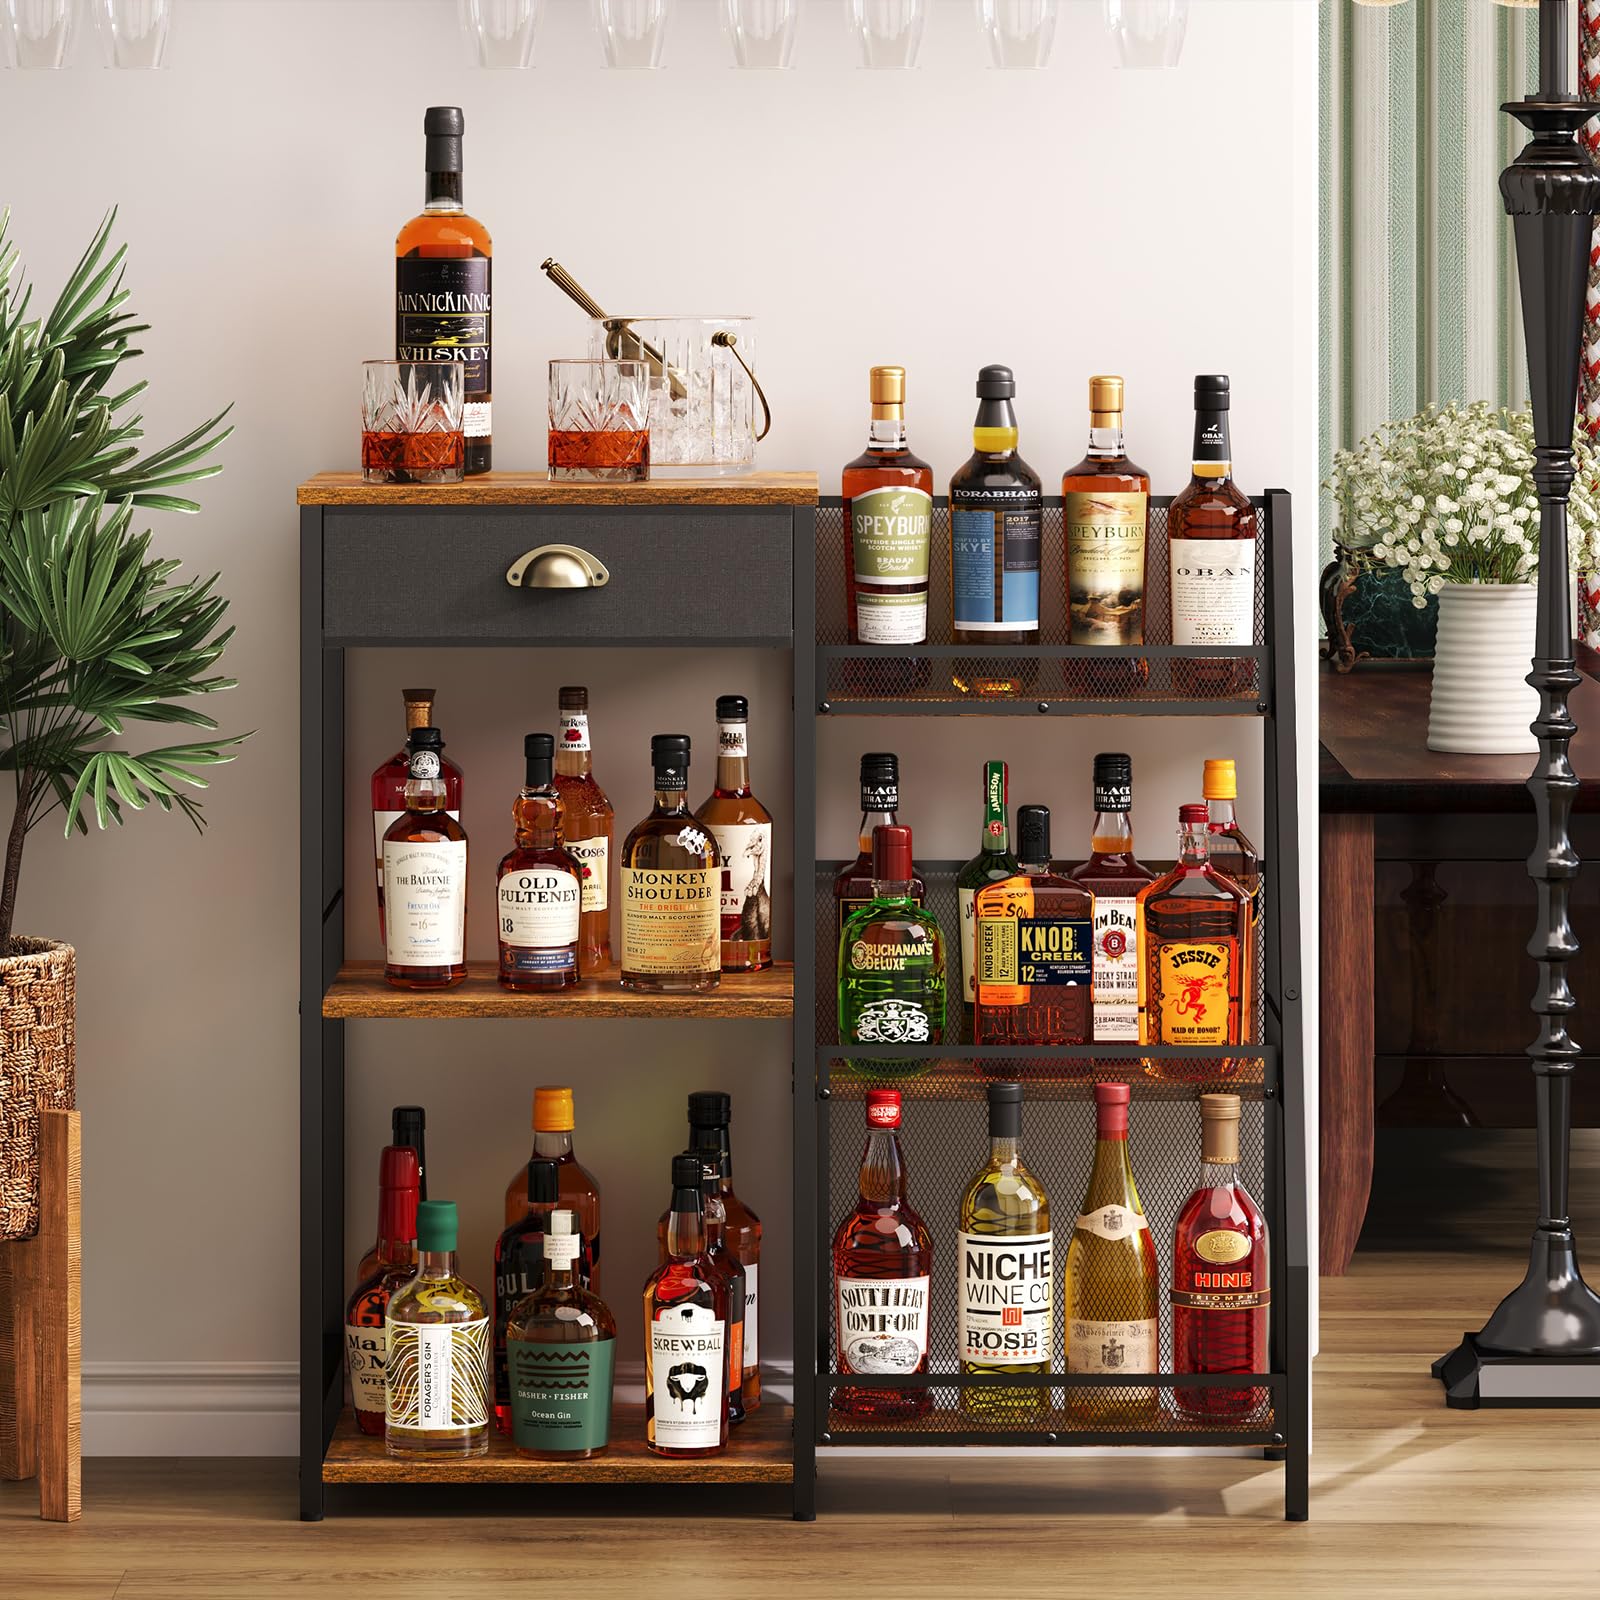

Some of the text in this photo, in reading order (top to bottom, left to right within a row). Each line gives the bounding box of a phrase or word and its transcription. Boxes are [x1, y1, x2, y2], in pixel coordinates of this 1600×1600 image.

[399, 347, 489, 360] WHISKEY
[954, 543, 991, 552] SKYE
[1177, 568, 1250, 576] OBAN
[863, 786, 897, 794] BLACK
[990, 772, 1000, 812] JAMESON
[1096, 786, 1130, 795] BLACK
[396, 876, 408, 885] THE
[519, 876, 558, 889] OLD
[632, 872, 706, 885] MONKEY
[501, 889, 577, 903] PULTENEY
[628, 886, 712, 900] SHOULDER
[418, 918, 428, 930] 16
[502, 918, 514, 933] 18
[1096, 914, 1108, 930] IM
[1022, 926, 1073, 952] KNOB
[866, 942, 934, 956] BUCHANAN'S
[985, 925, 993, 978] KNOB CREEK
[1031, 952, 1083, 960] CREEK
[1171, 950, 1221, 968] JESSIE
[1000, 969, 1008, 977] 12
[1021, 965, 1035, 982] 12
[1094, 972, 1114, 980] TUCKY
[1094, 981, 1114, 989] URBON
[966, 1250, 1050, 1280] NICHE
[1196, 1272, 1252, 1288] HINE
[966, 1282, 1024, 1304] WINE
[846, 1311, 920, 1332] COMFORT
[967, 1329, 1037, 1349] ROSÉ
[1041, 1314, 1050, 1358] 2013
[424, 1342, 432, 1418] FORAGER'S GIN
[518, 1391, 589, 1400] DASHER FISHER
[532, 1410, 555, 1419] Ocean
